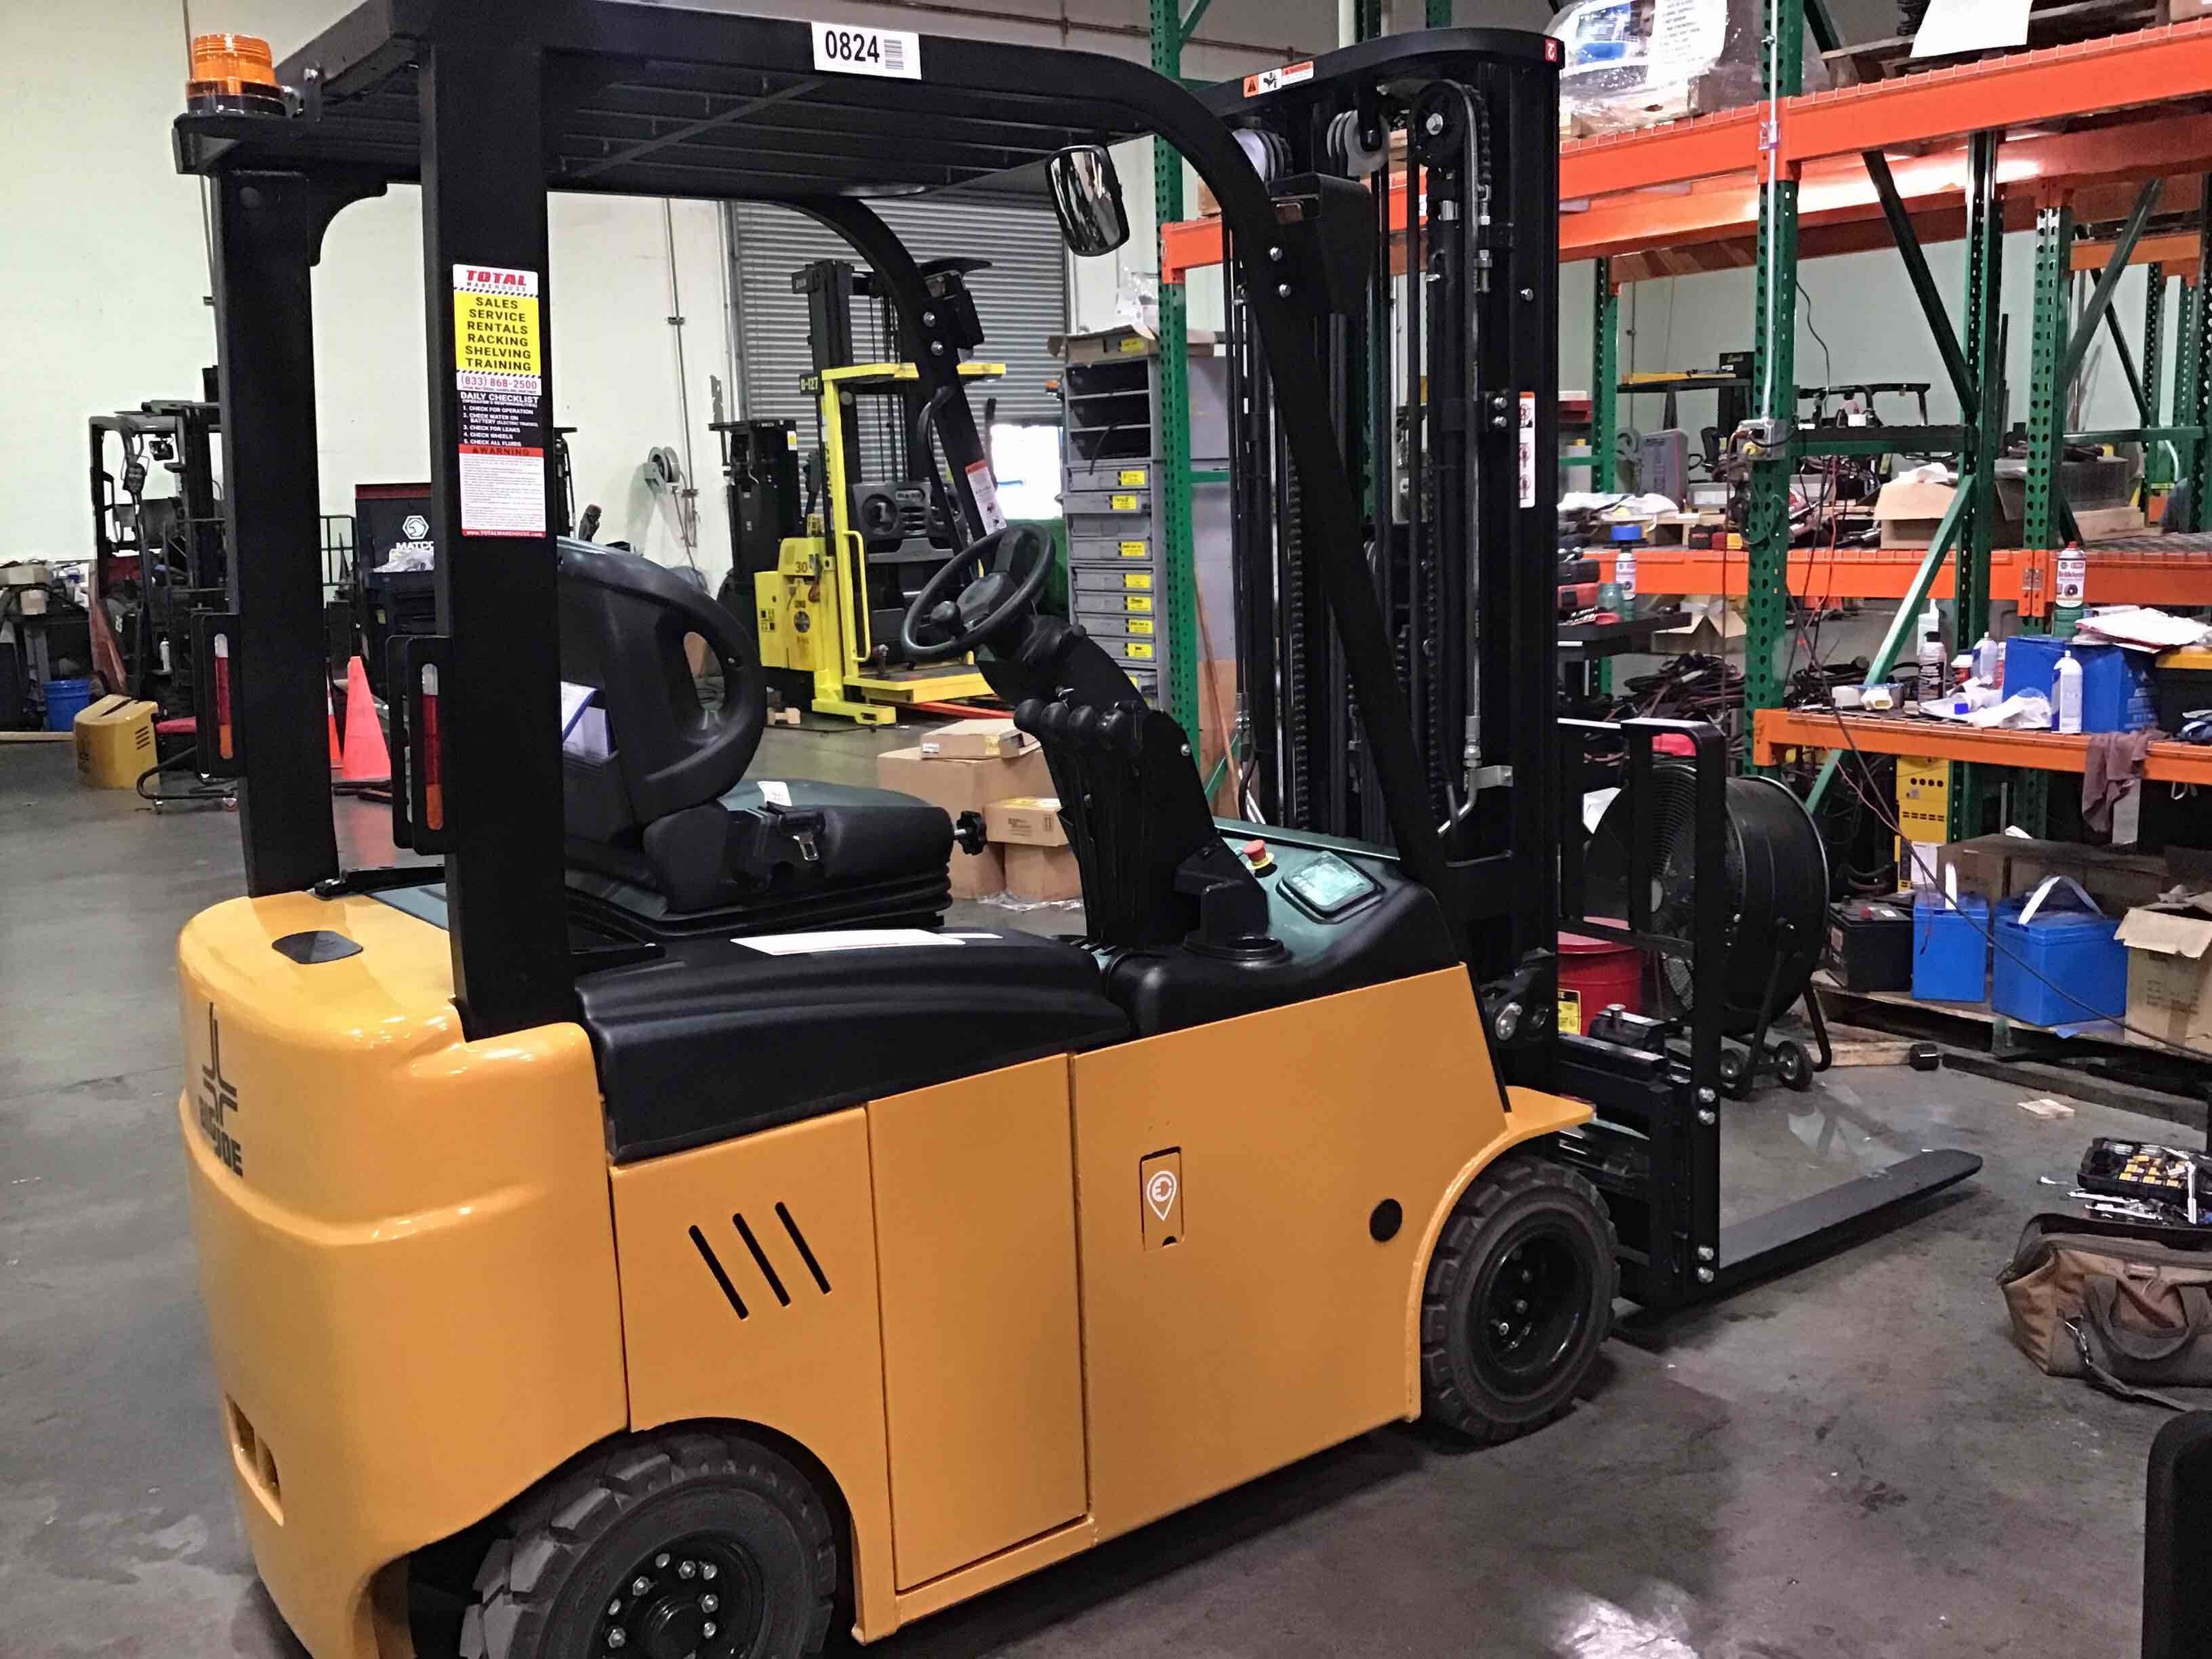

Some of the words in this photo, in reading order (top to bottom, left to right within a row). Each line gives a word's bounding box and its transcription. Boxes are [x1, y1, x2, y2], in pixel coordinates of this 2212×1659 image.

[825, 30, 880, 63] 0824
[466, 270, 527, 285] TOTAL
[476, 297, 518, 309] SALES
[468, 308, 527, 322] SERVICE
[467, 321, 529, 335] RENTALS
[468, 333, 529, 346] RACKING
[465, 346, 531, 359] SHELVING
[466, 358, 531, 371] TRAINING
[462, 375, 487, 386] (833)
[490, 378, 537, 390] 868-2500
[461, 392, 487, 401] DAILY
[489, 393, 539, 404] CHECKLIST
[478, 447, 530, 455] WARNING
[795, 561, 808, 573] 30
